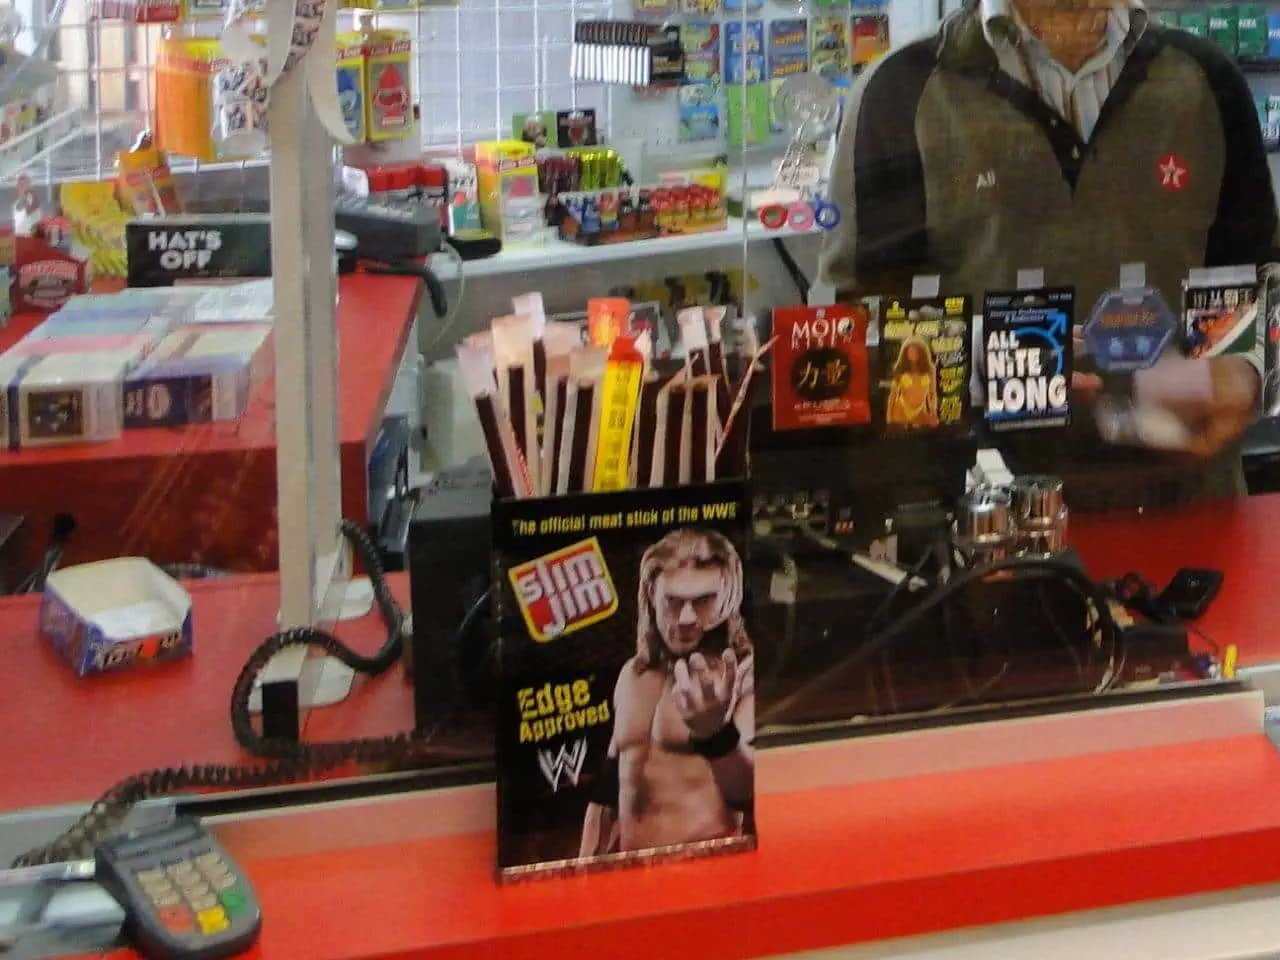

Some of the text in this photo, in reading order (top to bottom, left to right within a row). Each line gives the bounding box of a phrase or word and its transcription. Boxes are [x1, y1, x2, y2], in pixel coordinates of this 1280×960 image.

[160, 249, 213, 271] OFF
[987, 329, 1021, 351] ALL
[987, 374, 1067, 414] LONG
[511, 519, 537, 537] The
[539, 513, 586, 535] official
[588, 510, 624, 530] meat
[625, 507, 659, 526] stick
[661, 507, 676, 524] of
[676, 504, 699, 522] the
[516, 677, 593, 722] Edge
[519, 699, 612, 744] Approved
